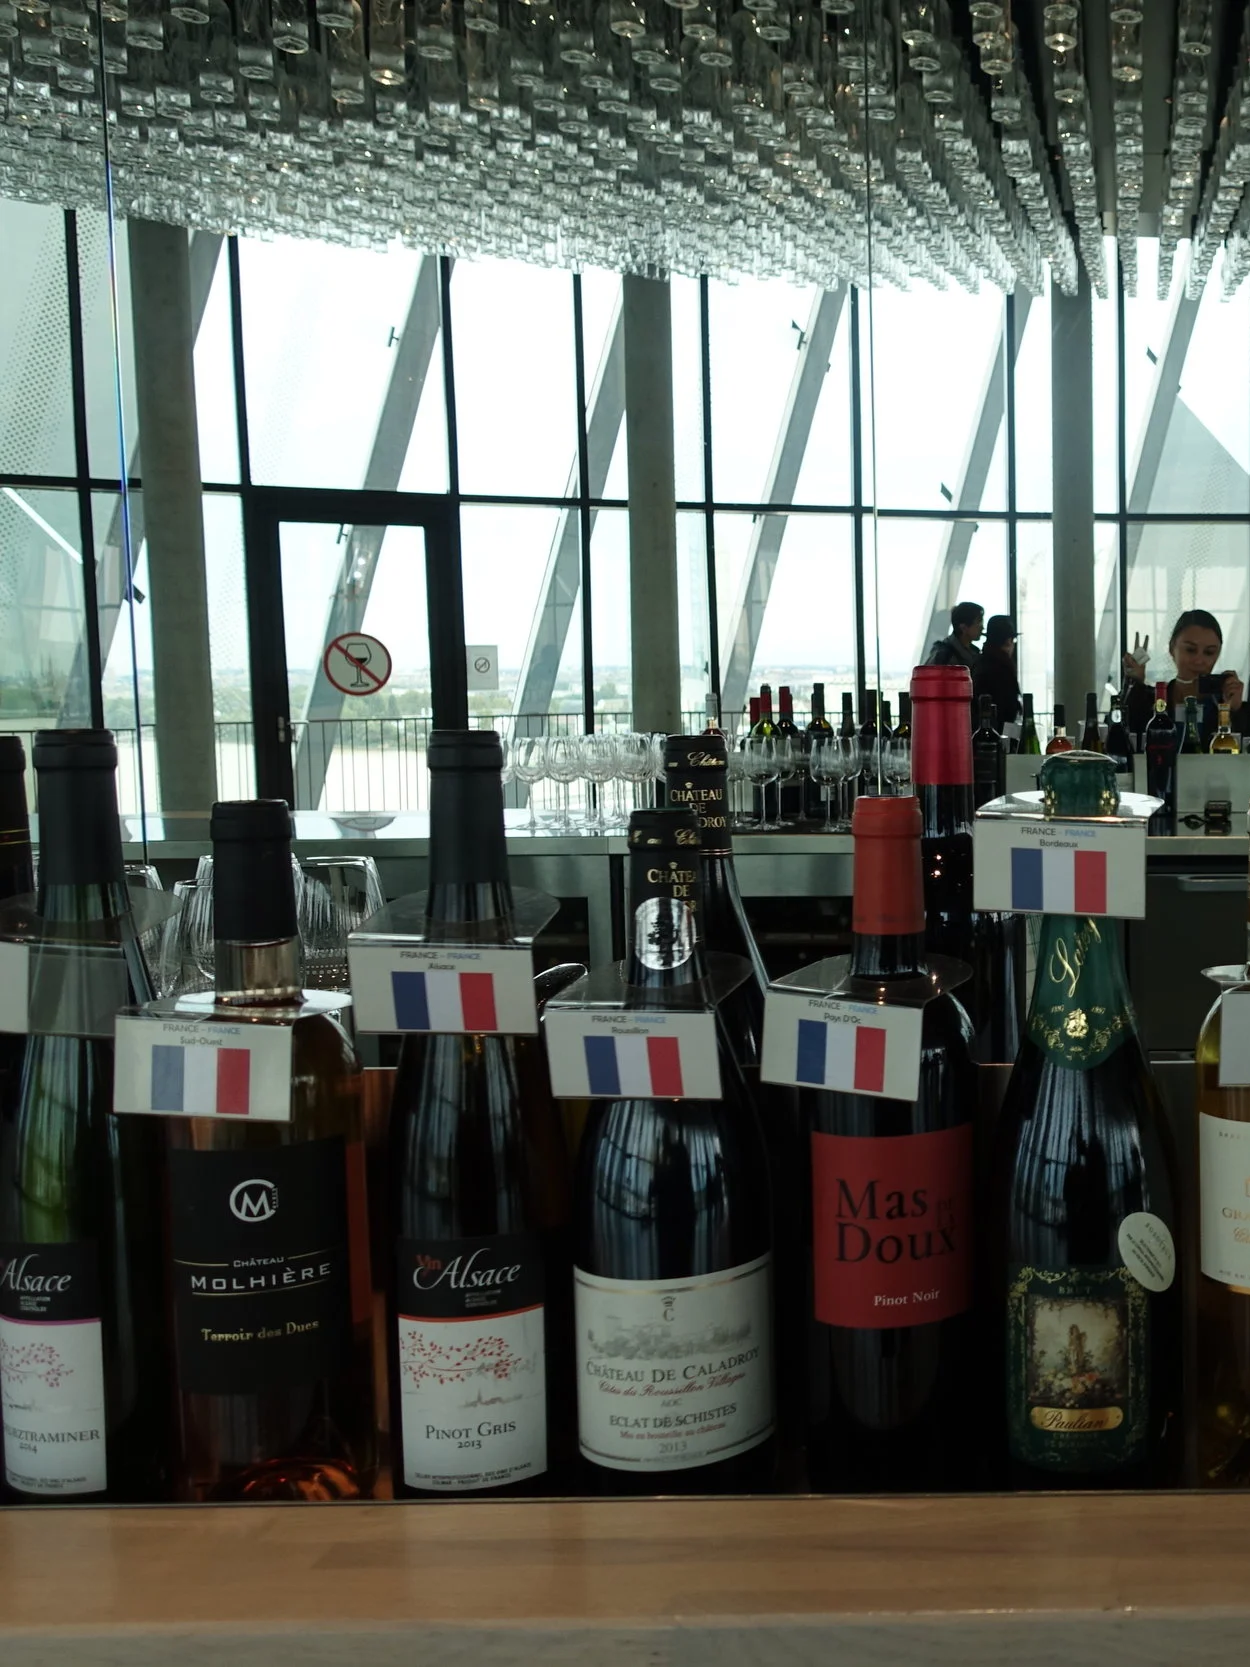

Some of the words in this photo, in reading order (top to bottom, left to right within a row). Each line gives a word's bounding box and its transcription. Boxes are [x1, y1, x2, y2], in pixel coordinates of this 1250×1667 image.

[670, 788, 723, 801] CHÂTEAU
[1021, 826, 1057, 836] FRANCE
[1064, 829, 1097, 837] FRANCE
[1039, 839, 1079, 848] Bordeaux
[673, 886, 690, 897] DE
[400, 951, 438, 959] FRANCE
[808, 1000, 840, 1010] FRANCE
[849, 1005, 878, 1014] FRANCE
[592, 1015, 626, 1023] FRANCE
[163, 1023, 199, 1032] FRANCE
[207, 1026, 241, 1034] FRANCE
[180, 1036, 222, 1046] Sud-Ouest
[836, 1178, 929, 1220] Mas
[836, 1222, 957, 1264] Doux
[233, 1256, 285, 1268] CHÂTEAU
[413, 1247, 522, 1290] Alsace
[0, 1253, 73, 1292] Alsace
[191, 1262, 331, 1290] MOLHIÈRE
[873, 1295, 908, 1307] Pinot
[912, 1289, 940, 1303] Noir
[663, 1308, 675, 1322] C
[201, 1328, 254, 1342] Terroir
[257, 1327, 282, 1339] des
[586, 1361, 644, 1382] CHÂTEAU
[652, 1369, 676, 1383] DE
[683, 1346, 760, 1379] CALADROY
[640, 1379, 704, 1397] Roussillon
[610, 1415, 648, 1429] ECLAT
[653, 1417, 673, 1428] DE
[675, 1402, 737, 1428] SCHISTES
[426, 1425, 472, 1440] PINOT
[477, 1421, 516, 1437] GRIS
[458, 1440, 482, 1449] 2013
[659, 1441, 688, 1454] 2013
